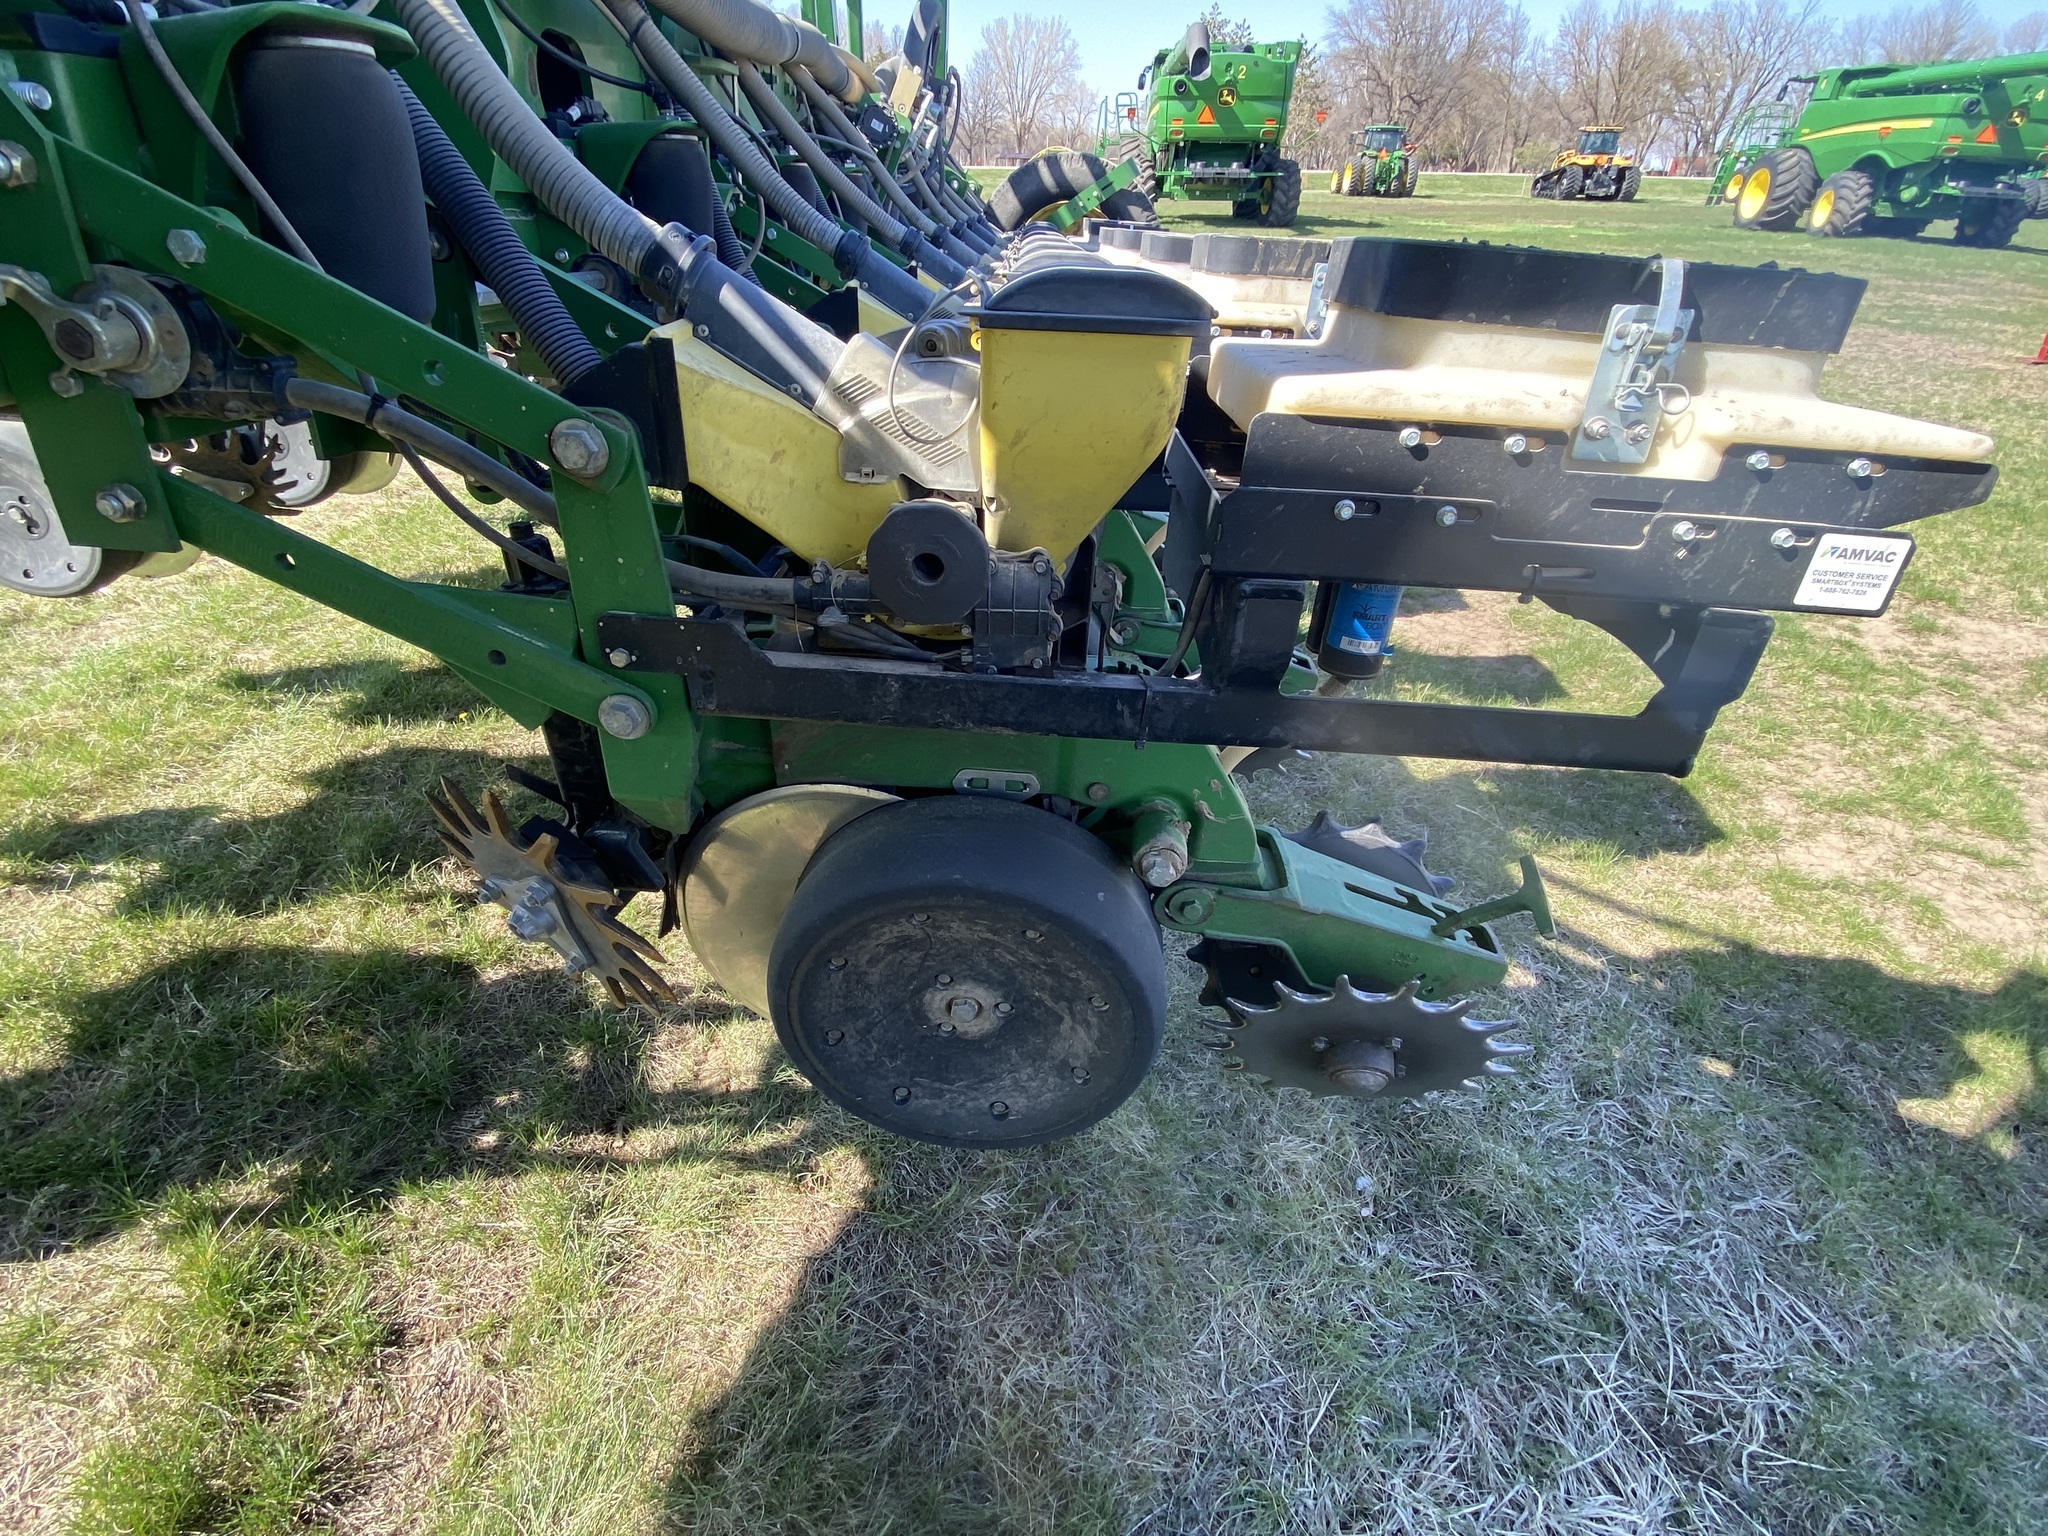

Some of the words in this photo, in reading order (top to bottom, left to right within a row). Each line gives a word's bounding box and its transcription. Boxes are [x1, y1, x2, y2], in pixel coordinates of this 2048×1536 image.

[1237, 65, 1246, 79] 2
[2034, 88, 2046, 102] 4
[1836, 548, 1897, 562] AMVAC
[1812, 570, 1854, 578] CUSTOMER
[1856, 573, 1889, 581] SERVICE
[1352, 611, 1387, 622] SMART
